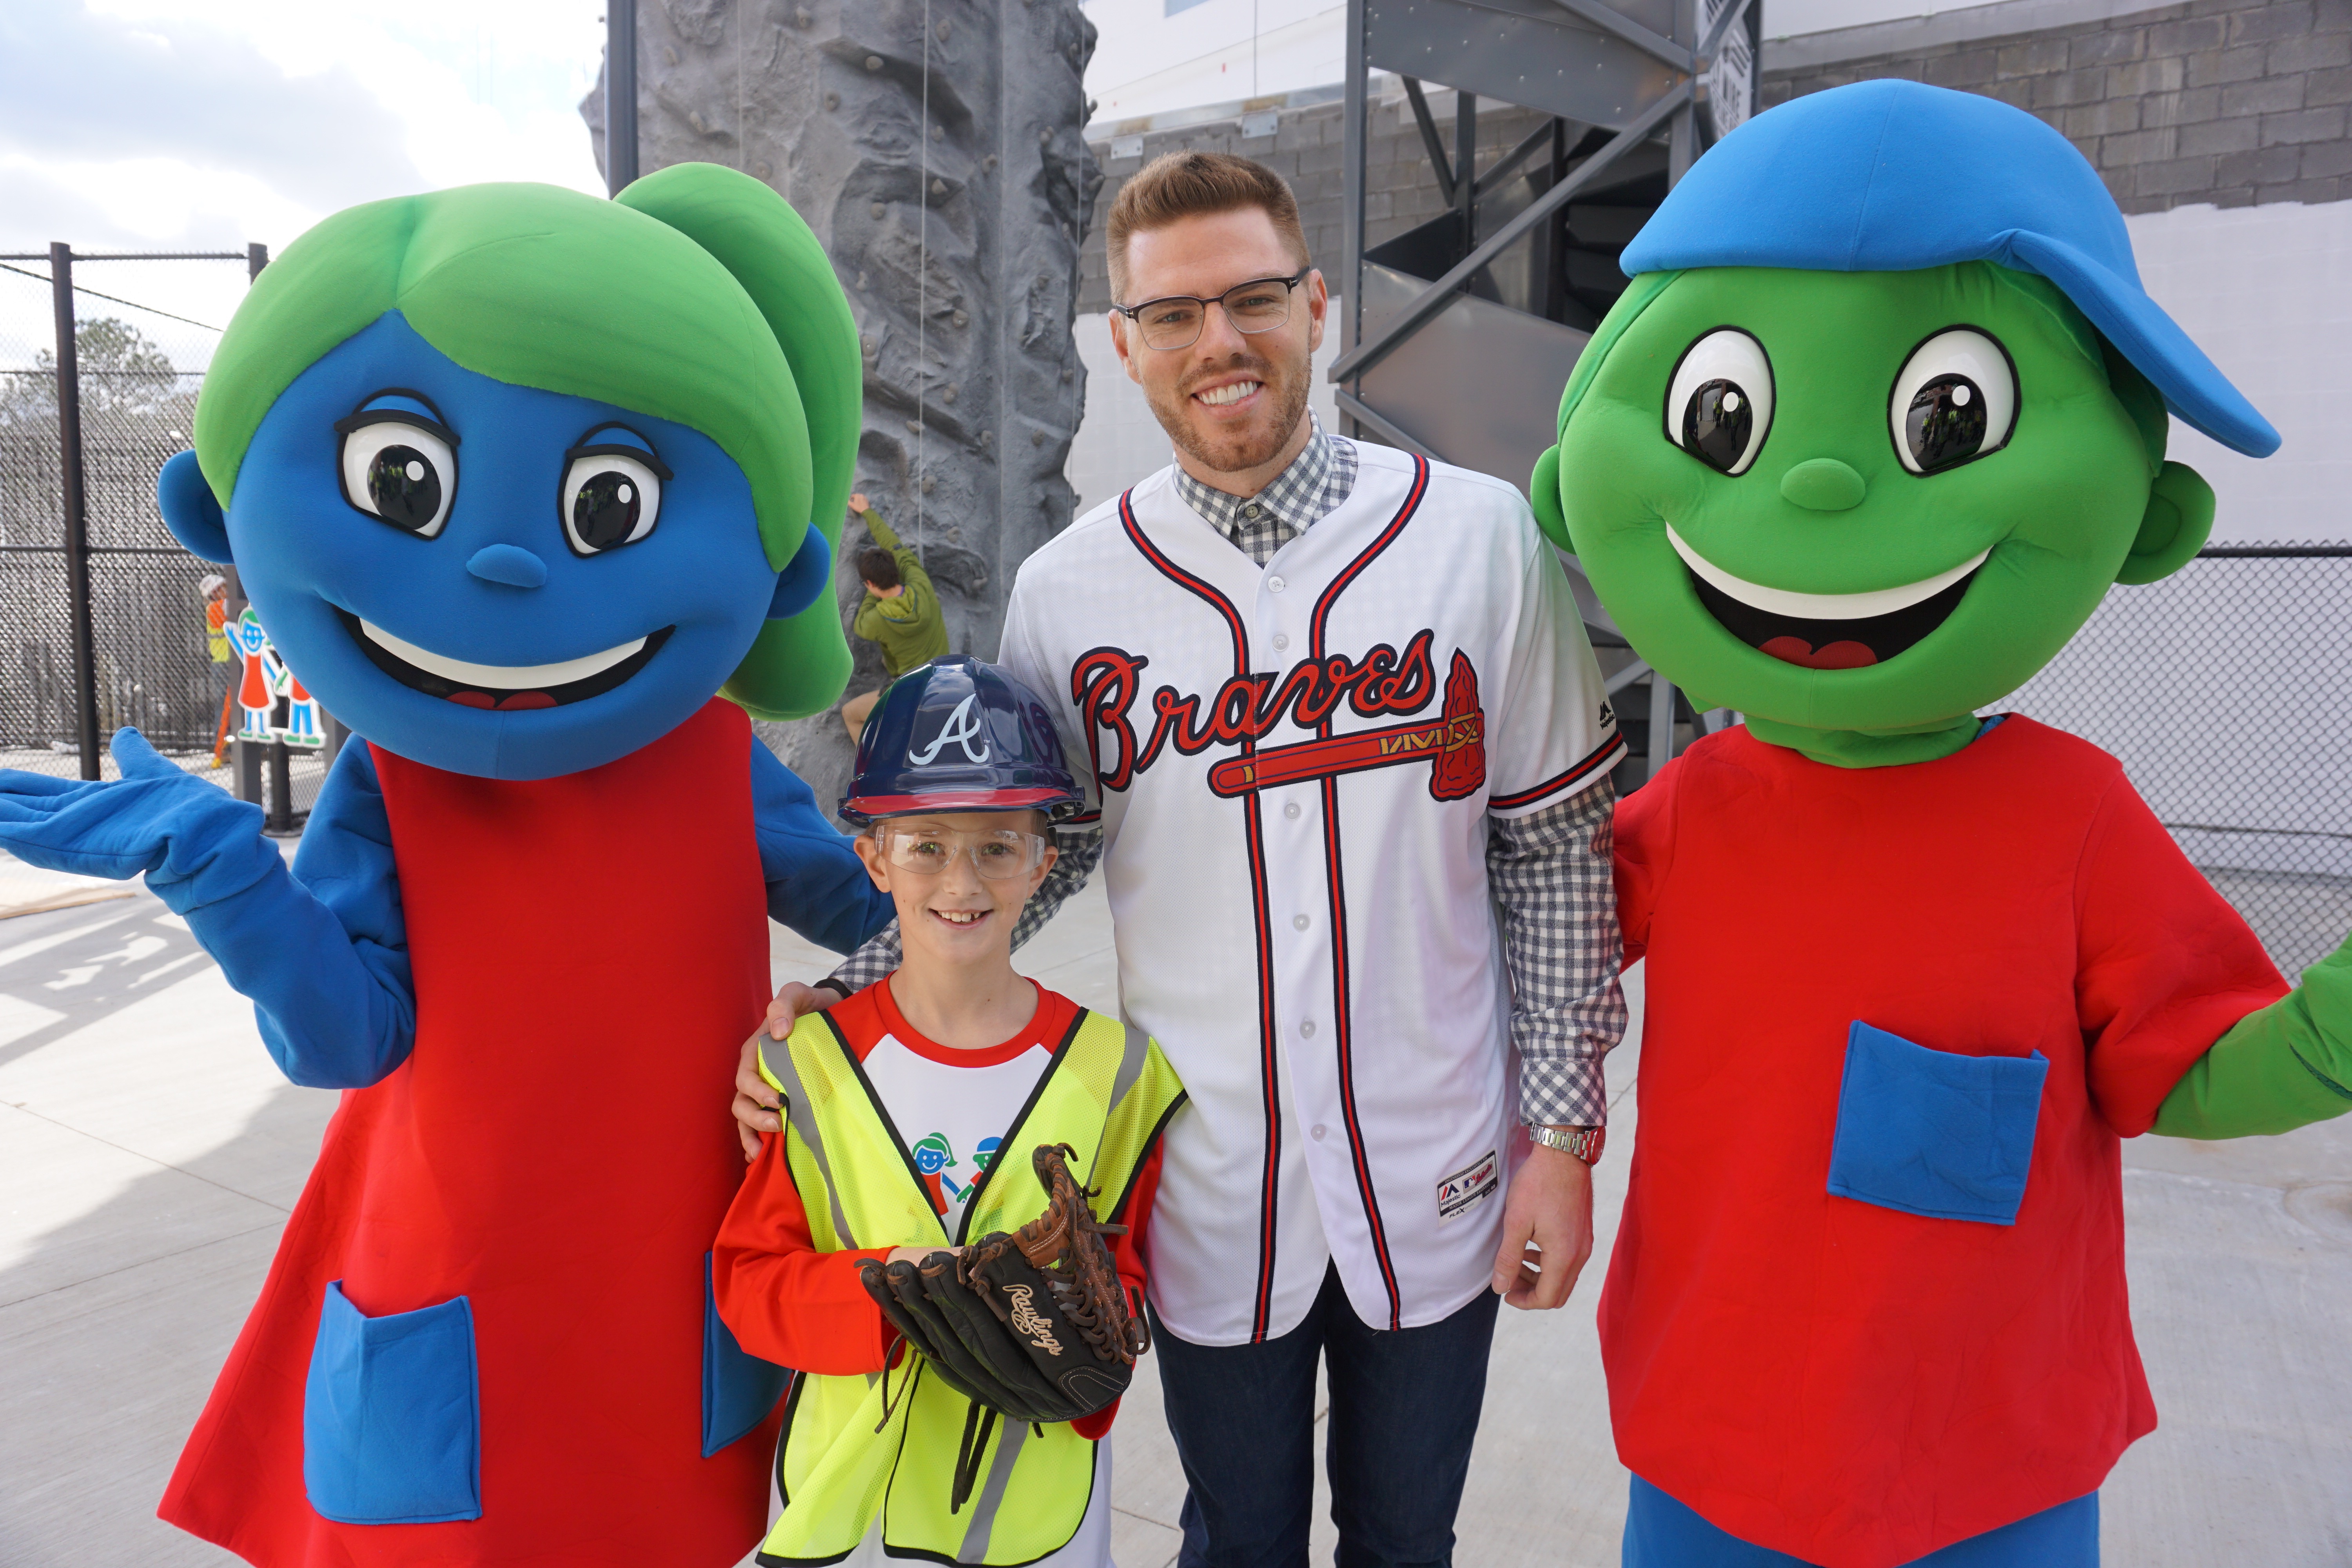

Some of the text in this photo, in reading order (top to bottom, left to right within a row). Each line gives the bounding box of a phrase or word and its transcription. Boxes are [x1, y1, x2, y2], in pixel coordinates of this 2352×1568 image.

[1070, 628, 1435, 805] Braves
[1600, 714, 1615, 730] Majestic
[909, 693, 989, 765] A
[1441, 1195, 1461, 1207] Majestic
[1449, 1201, 1463, 1210] MAJOR
[1463, 1193, 1476, 1204] LEAGUE
[1449, 1207, 1465, 1219] FLEX
[1002, 1284, 1063, 1356] Rawlings
